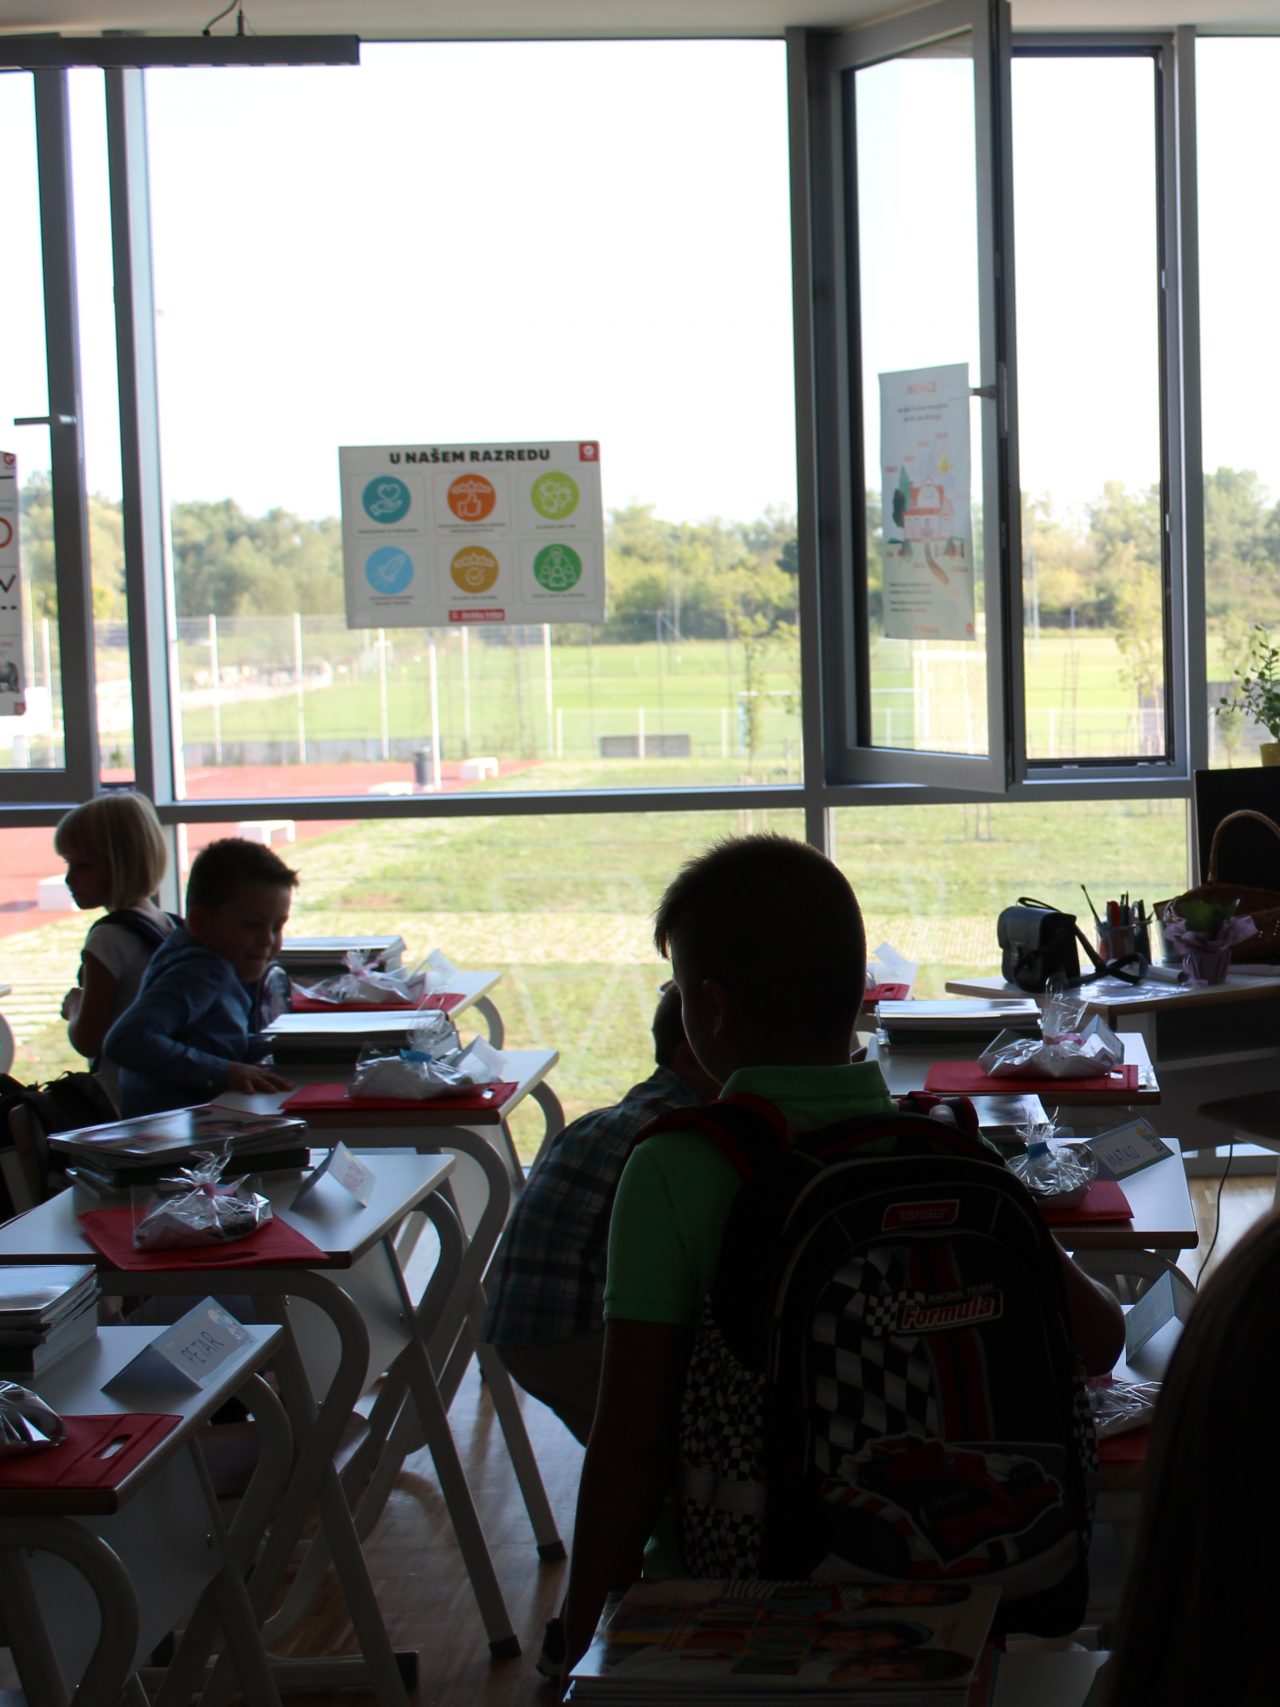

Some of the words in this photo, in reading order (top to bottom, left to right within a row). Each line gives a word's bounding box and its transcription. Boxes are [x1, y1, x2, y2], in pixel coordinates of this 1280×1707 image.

[390, 452, 400, 464] U
[406, 447, 465, 464] NAŠEM
[470, 449, 549, 463] RAZREDU
[897, 1208, 946, 1223] TARGET
[901, 1295, 994, 1328] Formula
[180, 1331, 225, 1364] PETAR
